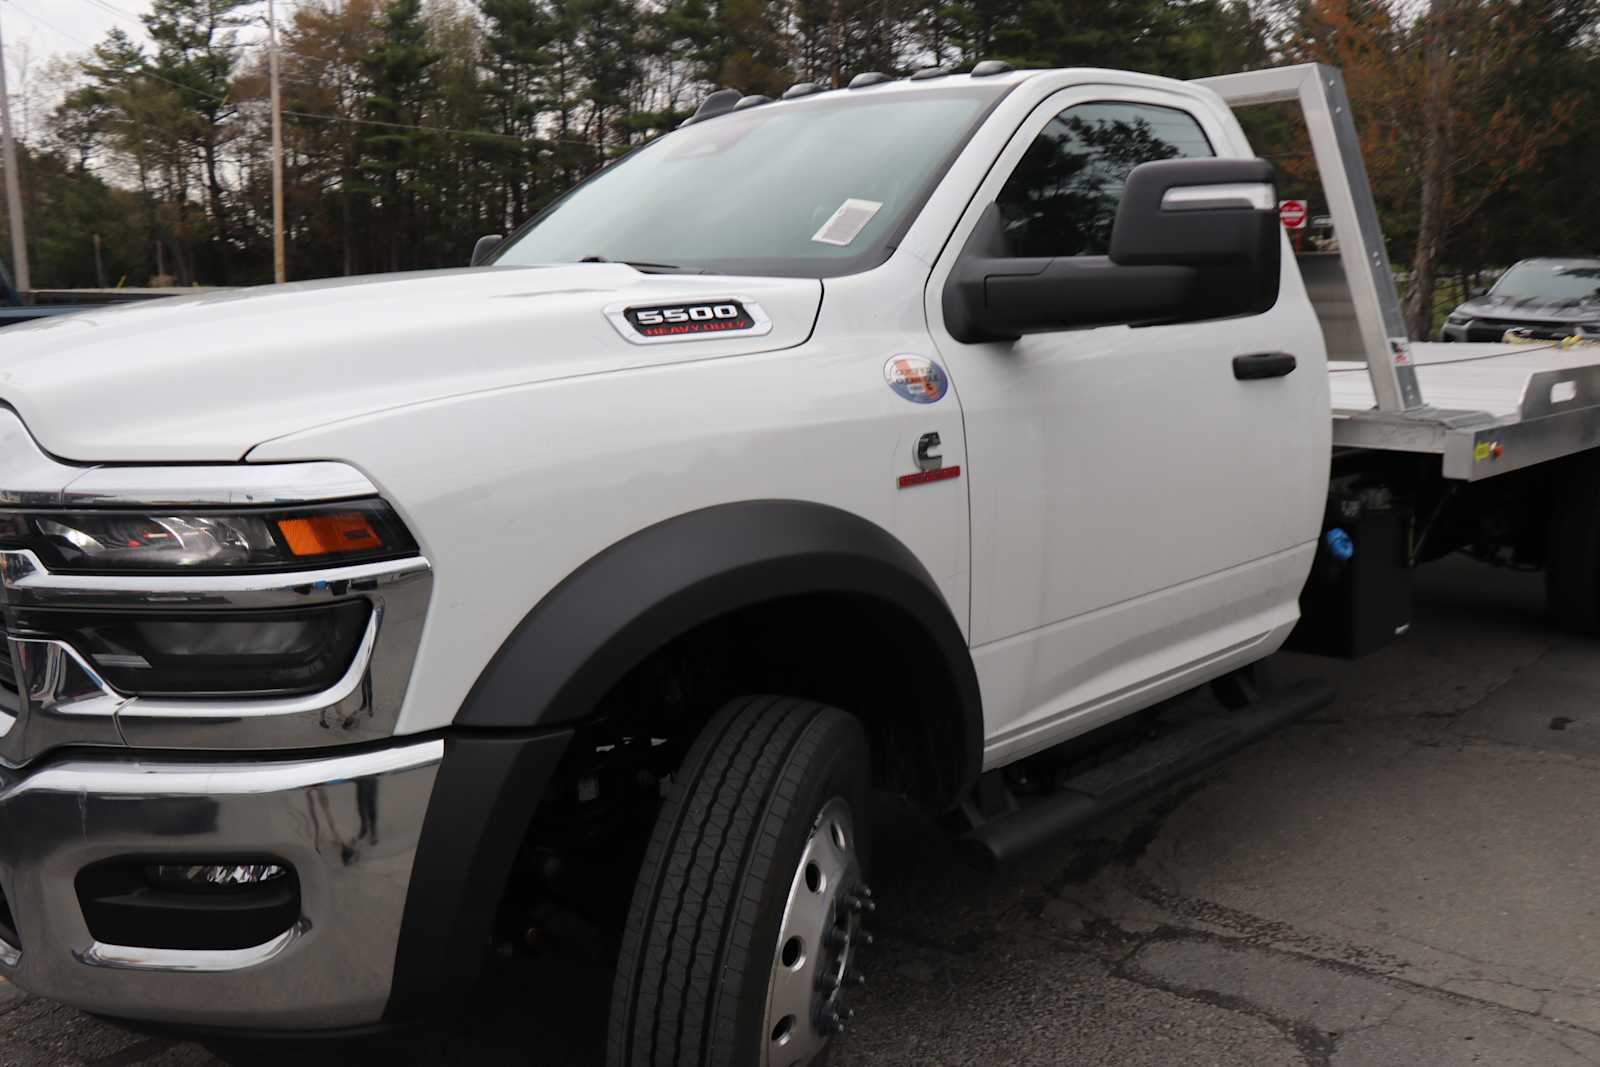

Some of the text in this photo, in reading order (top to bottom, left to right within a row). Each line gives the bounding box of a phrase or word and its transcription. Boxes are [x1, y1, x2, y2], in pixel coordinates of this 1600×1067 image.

[637, 304, 738, 325] 5500
[643, 321, 746, 336] HEAVY DUTY
